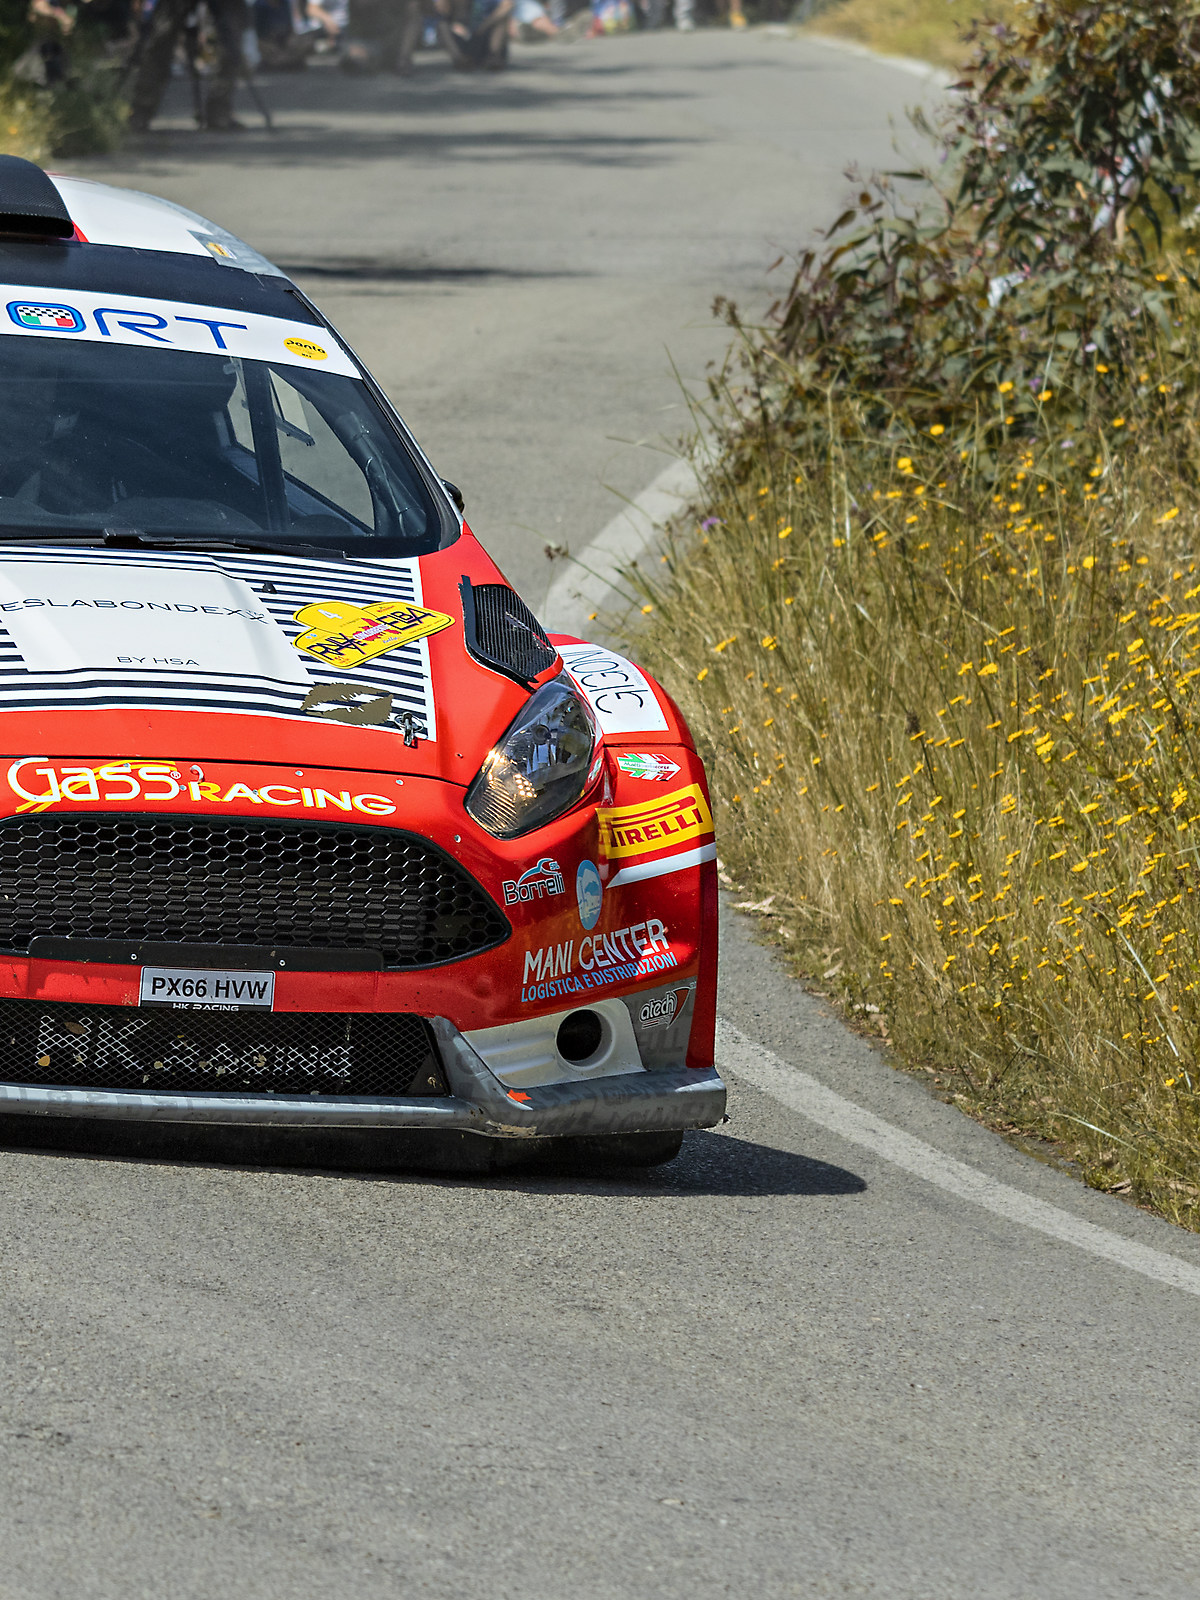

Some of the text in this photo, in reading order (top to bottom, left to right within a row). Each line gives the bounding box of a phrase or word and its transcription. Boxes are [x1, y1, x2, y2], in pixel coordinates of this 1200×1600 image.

[376, 606, 437, 630] ELBA
[117, 656, 200, 667] BY HSA
[6, 756, 397, 816] Gass RACING
[603, 795, 704, 848] PIRELLI
[502, 872, 565, 906] Borrelli
[522, 918, 670, 985] MANI CENTER
[151, 977, 269, 1000] PX66 HVW
[520, 951, 678, 1003] LOGISTICA E DISTRIBUZIONI
[172, 1002, 240, 1012] HK RACING
[640, 992, 675, 1021] atech
[35, 1014, 152, 1070] HK
